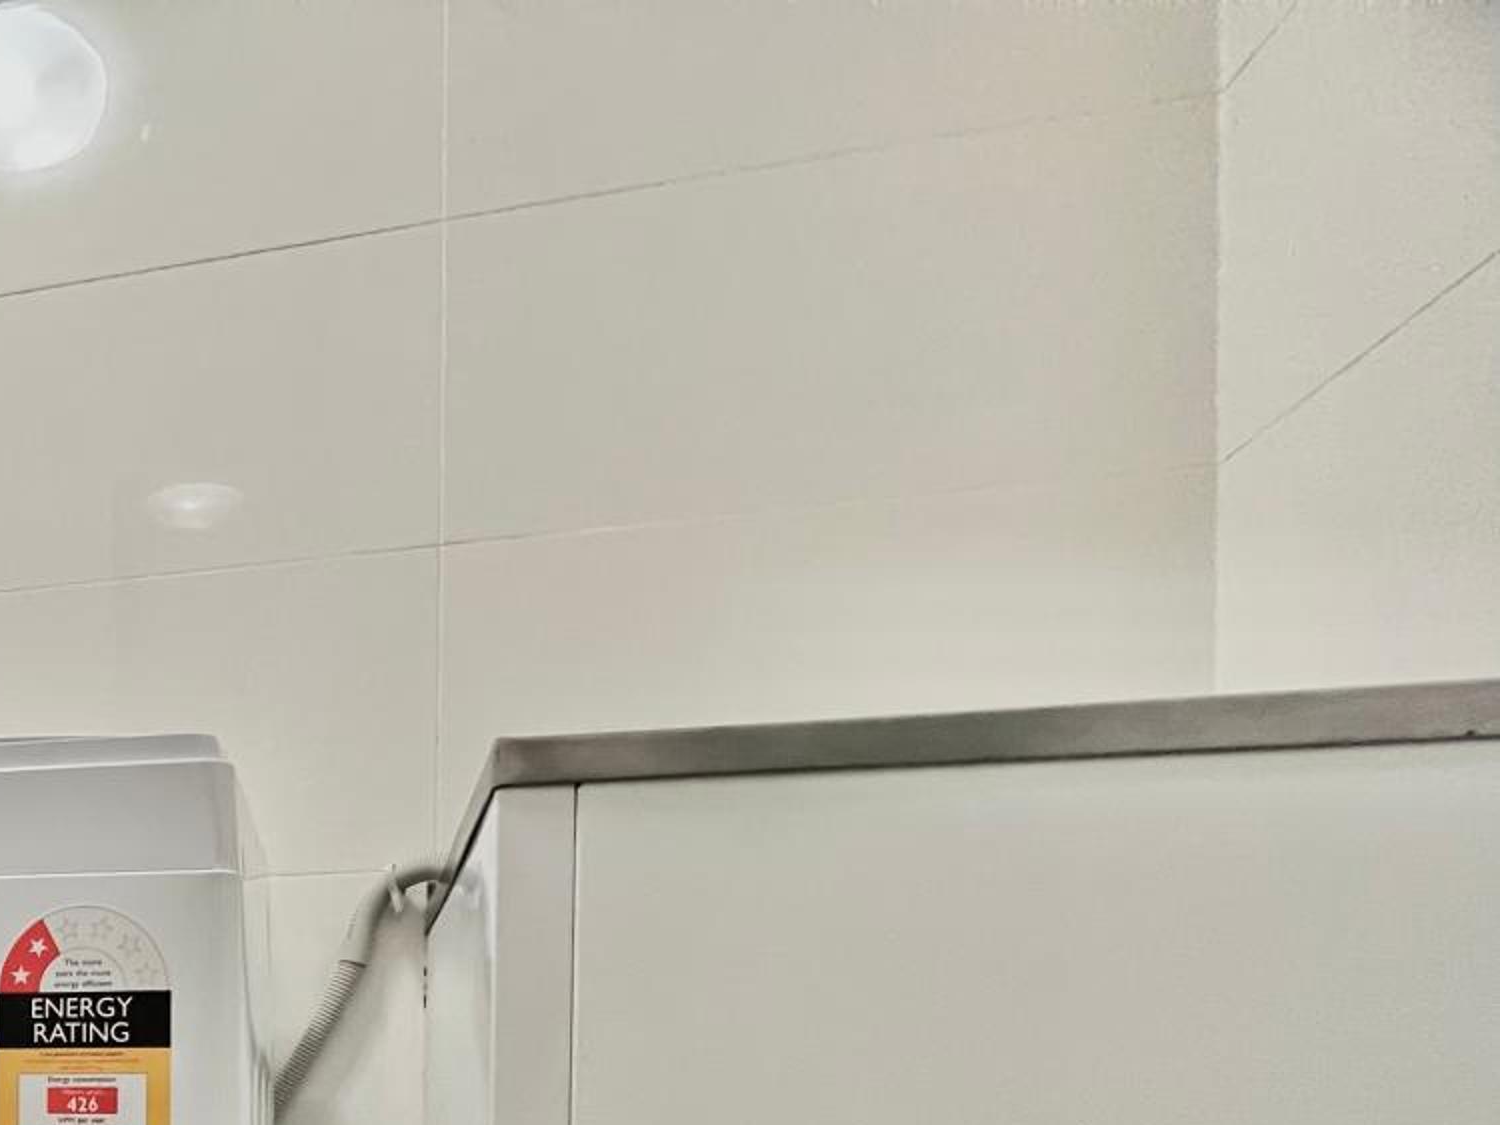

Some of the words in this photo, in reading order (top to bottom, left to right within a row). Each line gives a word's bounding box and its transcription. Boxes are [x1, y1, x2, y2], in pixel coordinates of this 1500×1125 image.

[31, 996, 133, 1019] ENERGY
[33, 1022, 130, 1043] RATING
[67, 1096, 99, 1112] 426
